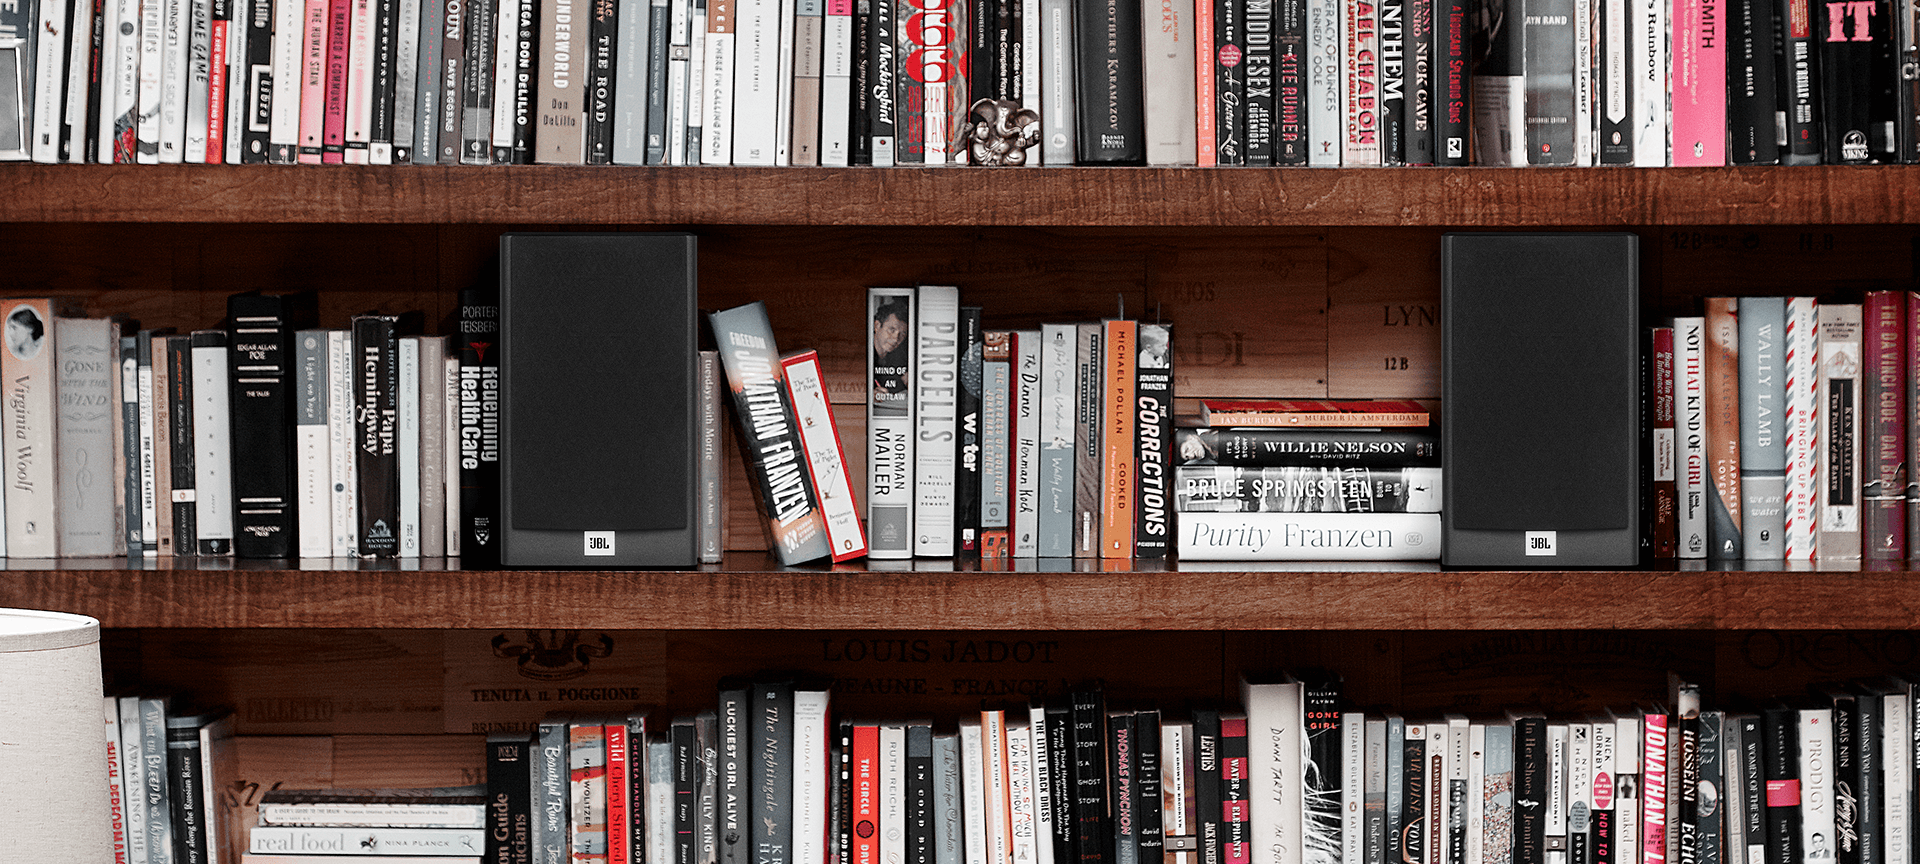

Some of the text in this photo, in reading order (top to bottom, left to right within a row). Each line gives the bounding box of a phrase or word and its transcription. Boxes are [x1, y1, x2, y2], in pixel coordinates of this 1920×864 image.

[192, 2, 208, 83] HOME GAME
[309, 8, 322, 86] THE HUMAN STAIN
[1543, 15, 1568, 25] RAND
[1648, 13, 1657, 81] Rainbow
[1826, 1, 1876, 42] IT
[873, 28, 893, 124] A Mockingbird
[1246, 0, 1271, 98] MIDDLESEX
[1282, 54, 1298, 84] KITE
[445, 59, 457, 132] DAVE EGGERS
[595, 35, 610, 123] THE ROAD
[1358, 50, 1375, 144] CHABON
[1415, 41, 1427, 131] NICK CAVE
[1249, 102, 1259, 149] EUGENIDES
[1259, 107, 1269, 144] JEFFREY
[1282, 86, 1298, 141] RUNNER
[462, 306, 497, 318] PORTER
[1383, 305, 1441, 327] LYN
[63, 360, 104, 374] GONE
[249, 351, 266, 360] POE
[729, 331, 767, 350] FREEDOM
[1384, 357, 1409, 370] 12 B
[874, 366, 907, 375] MIND OF
[885, 380, 897, 388] AN
[920, 321, 956, 442] PARCELLS
[1115, 331, 1125, 434] MICHAEL POLLAN
[1139, 374, 1169, 382] JONATHAN
[1141, 383, 1167, 391] FRANZEN
[1758, 324, 1772, 447] WALLY LAMB
[1880, 304, 1897, 459] THE DA VINCI CODE DAN
[355, 346, 379, 457] Hemingway
[461, 366, 481, 470] Health Care
[703, 359, 715, 461] tuesdays with Morrie
[1221, 416, 1282, 424] JAN BURUMA
[1304, 414, 1344, 422] MURDER
[1361, 413, 1419, 422] AMSTERDAM
[1686, 325, 1701, 489] NOT THAT KIND OF GIRL
[10, 374, 33, 494] Virginia Woolf
[378, 409, 395, 456] Papa
[734, 350, 811, 529] JONATHAN FRANZEN
[963, 412, 979, 472] water
[1019, 353, 1038, 514] The Dinner Herman Koch
[1263, 441, 1407, 453] WILLIE NELSON
[1798, 410, 1807, 488] BRINGING UP
[1844, 407, 1853, 477] KEN FOLLETT
[874, 428, 890, 496] MAILER
[894, 434, 906, 490] NORMAN
[1118, 462, 1126, 509] COOKED
[1138, 396, 1166, 537] CORRECTIONS
[1186, 479, 1371, 498] BRUCE SPRINGSTEEN
[1718, 460, 1726, 496] LOVER
[1729, 459, 1738, 515] JAPANESE
[589, 537, 610, 549] JBL
[1192, 522, 1393, 553] Purity Franzen
[1531, 537, 1551, 549] JBL
[821, 638, 1059, 664] LOUIS JADOT
[471, 687, 640, 703] TENUTA POGGIONE
[1308, 711, 1339, 719] GONE
[1310, 722, 1337, 730] GIRL
[1595, 728, 1603, 770] HORNBY
[726, 701, 736, 830] LUCKIEST GIRL ALIVE
[763, 707, 778, 811] The Nightingale
[861, 759, 869, 814] THE CIRCLE
[1036, 720, 1050, 823] THE LITTLE BLACK DRESS
[1117, 729, 1131, 835] THOMAS PYNCHON
[1270, 728, 1285, 805] DONNA TARTT
[1645, 722, 1666, 825] JONATHAN
[1683, 730, 1695, 801] HOSSEINI
[1809, 740, 1824, 814] PRODIGY
[543, 745, 563, 832] Beautiful Ruins
[609, 732, 624, 862] wild Cheryl Strayed
[889, 777, 897, 818] REICHL
[257, 833, 344, 851] real food
[493, 793, 508, 841] Guide
[704, 795, 712, 852] LILY KING
[1598, 813, 1608, 856] HOW TO
[1622, 810, 1633, 843] naked
